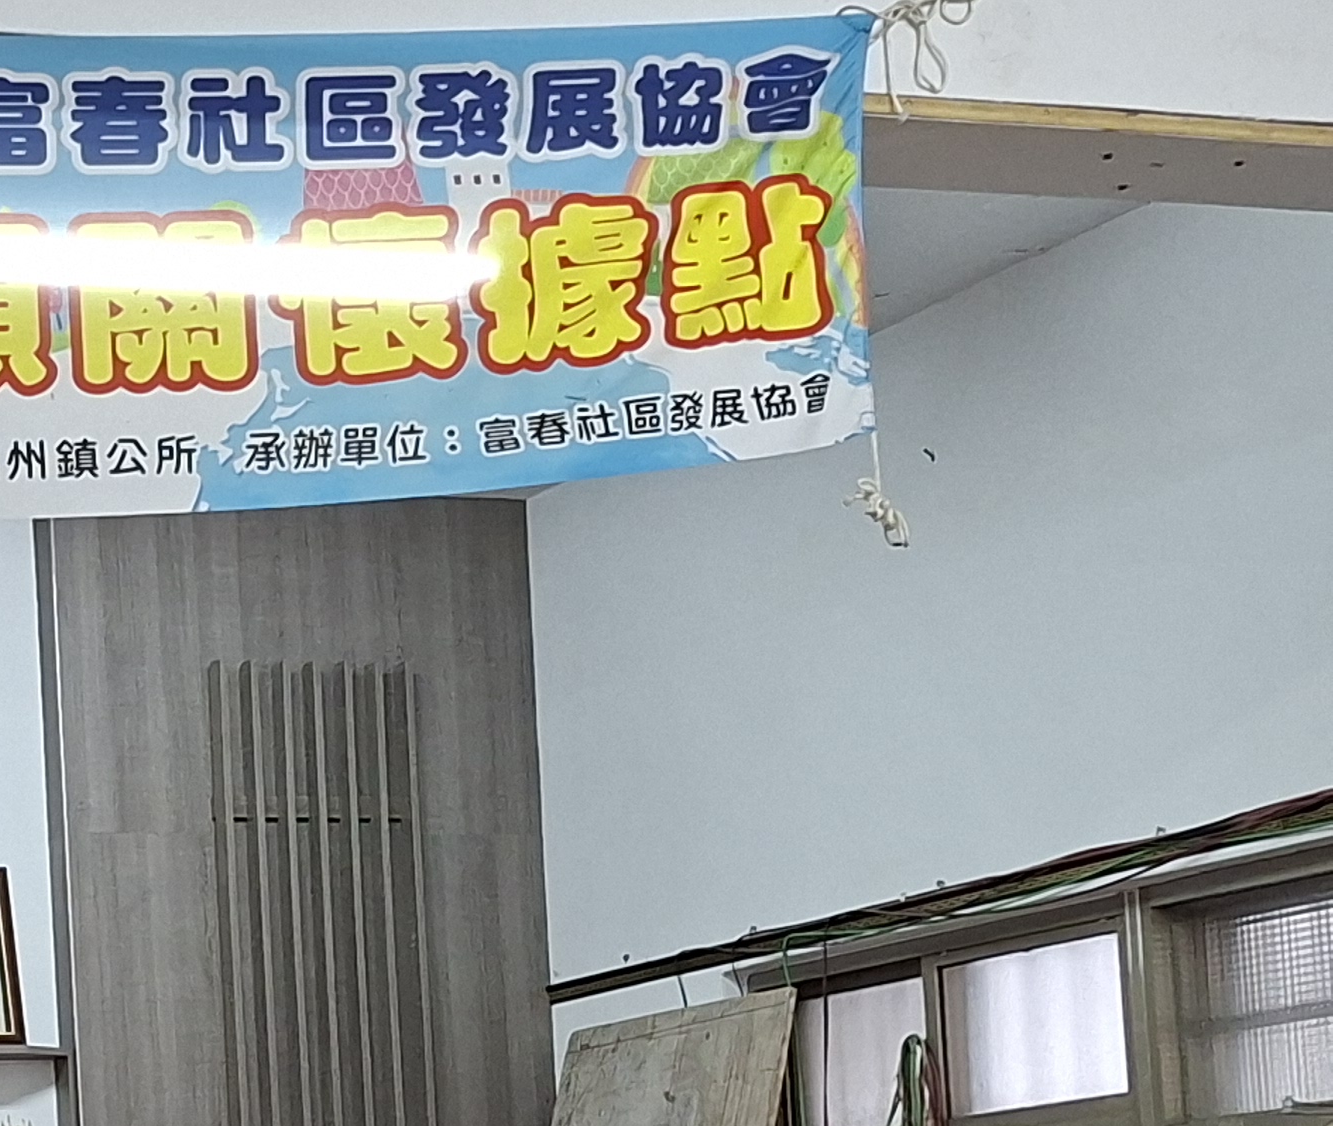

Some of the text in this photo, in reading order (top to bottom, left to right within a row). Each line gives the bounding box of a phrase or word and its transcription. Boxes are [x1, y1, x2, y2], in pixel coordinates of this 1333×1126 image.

[244, 372, 832, 471] 承辦單位：富春社區發展協會
